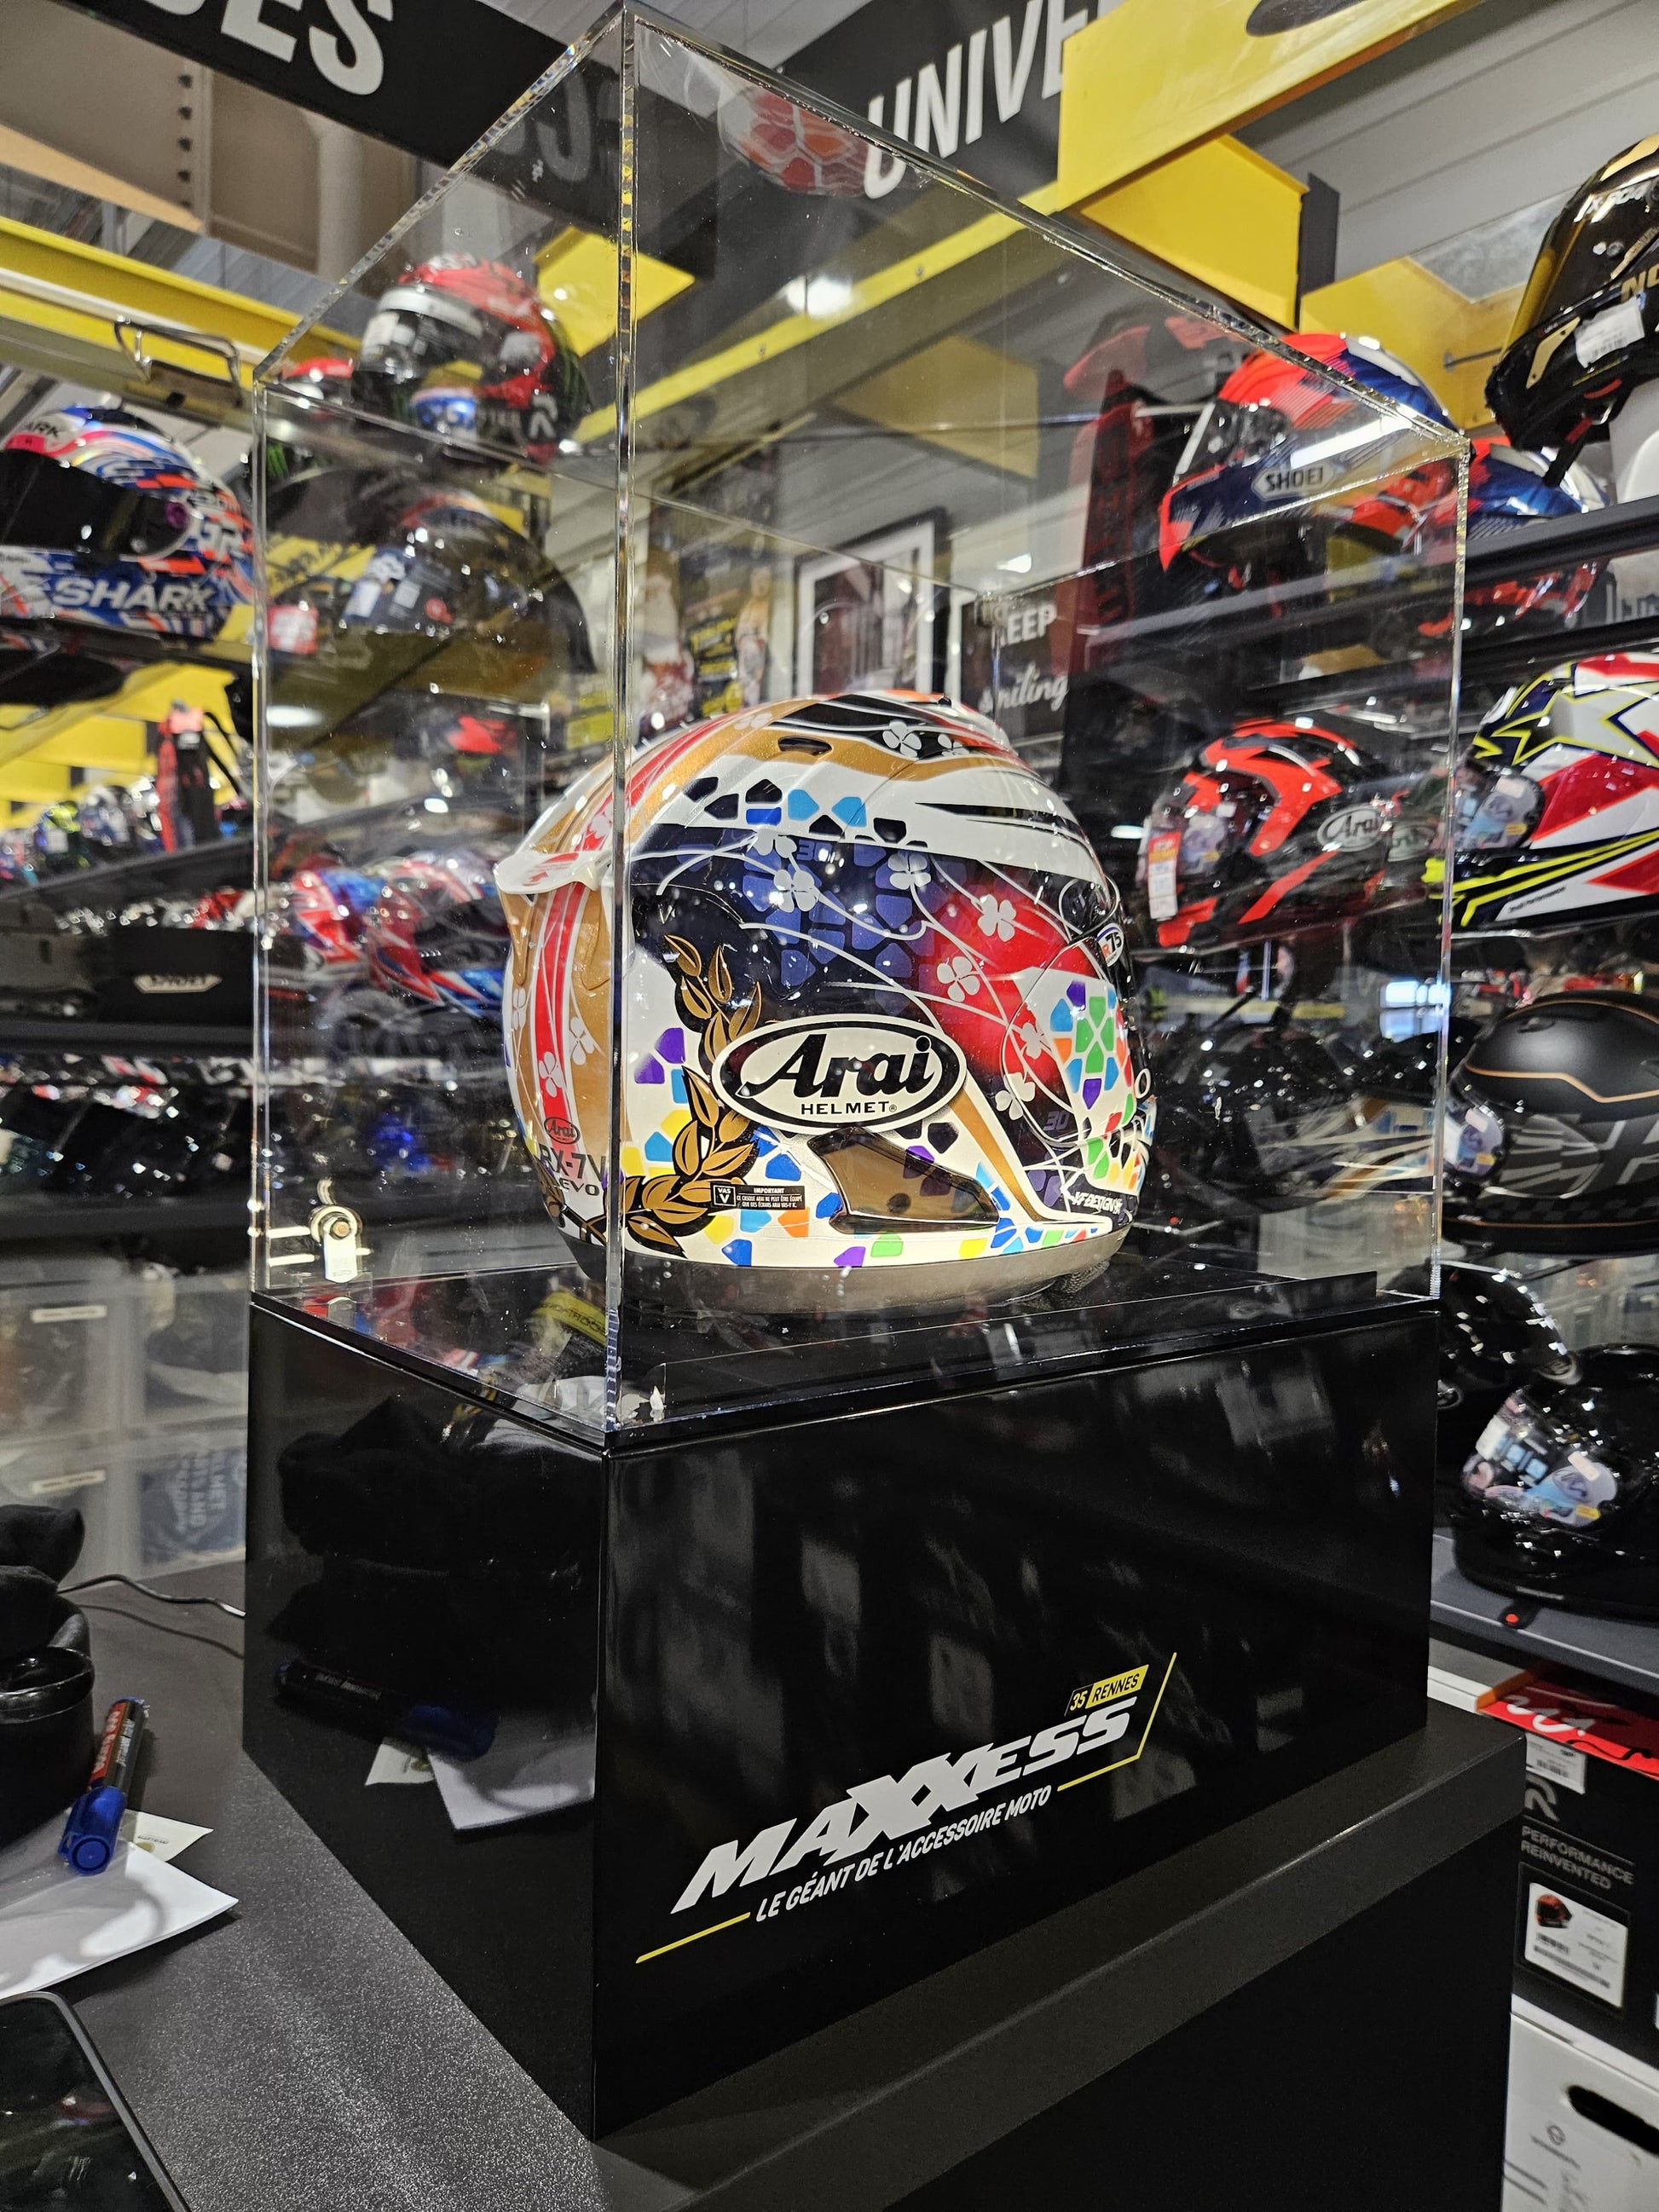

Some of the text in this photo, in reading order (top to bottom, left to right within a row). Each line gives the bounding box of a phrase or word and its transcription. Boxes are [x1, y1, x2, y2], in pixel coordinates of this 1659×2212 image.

[143, 0, 393, 95] ES
[864, 0, 1124, 199] UNIVE
[1265, 466, 1324, 493] SHOEI
[51, 577, 215, 613] SHARK
[735, 1033, 936, 1099] Arai
[547, 1119, 576, 1138] Arai
[1043, 1110, 1071, 1132] 30
[539, 1143, 607, 1182] RX-7V
[558, 1178, 600, 1197] EVO
[719, 1193, 730, 1204] V
[1070, 1672, 1140, 1712] 35 RENNES
[671, 1696, 1138, 1915] MAXXESS
[756, 1891, 787, 1923] LE
[785, 1863, 855, 1912] GÉANT
[854, 1851, 884, 1882] DE
[1003, 1784, 1053, 1822] MOTO
[1520, 1839, 1613, 1890] REINVENTED
[1522, 1825, 1637, 1886] PERFORMANCE
